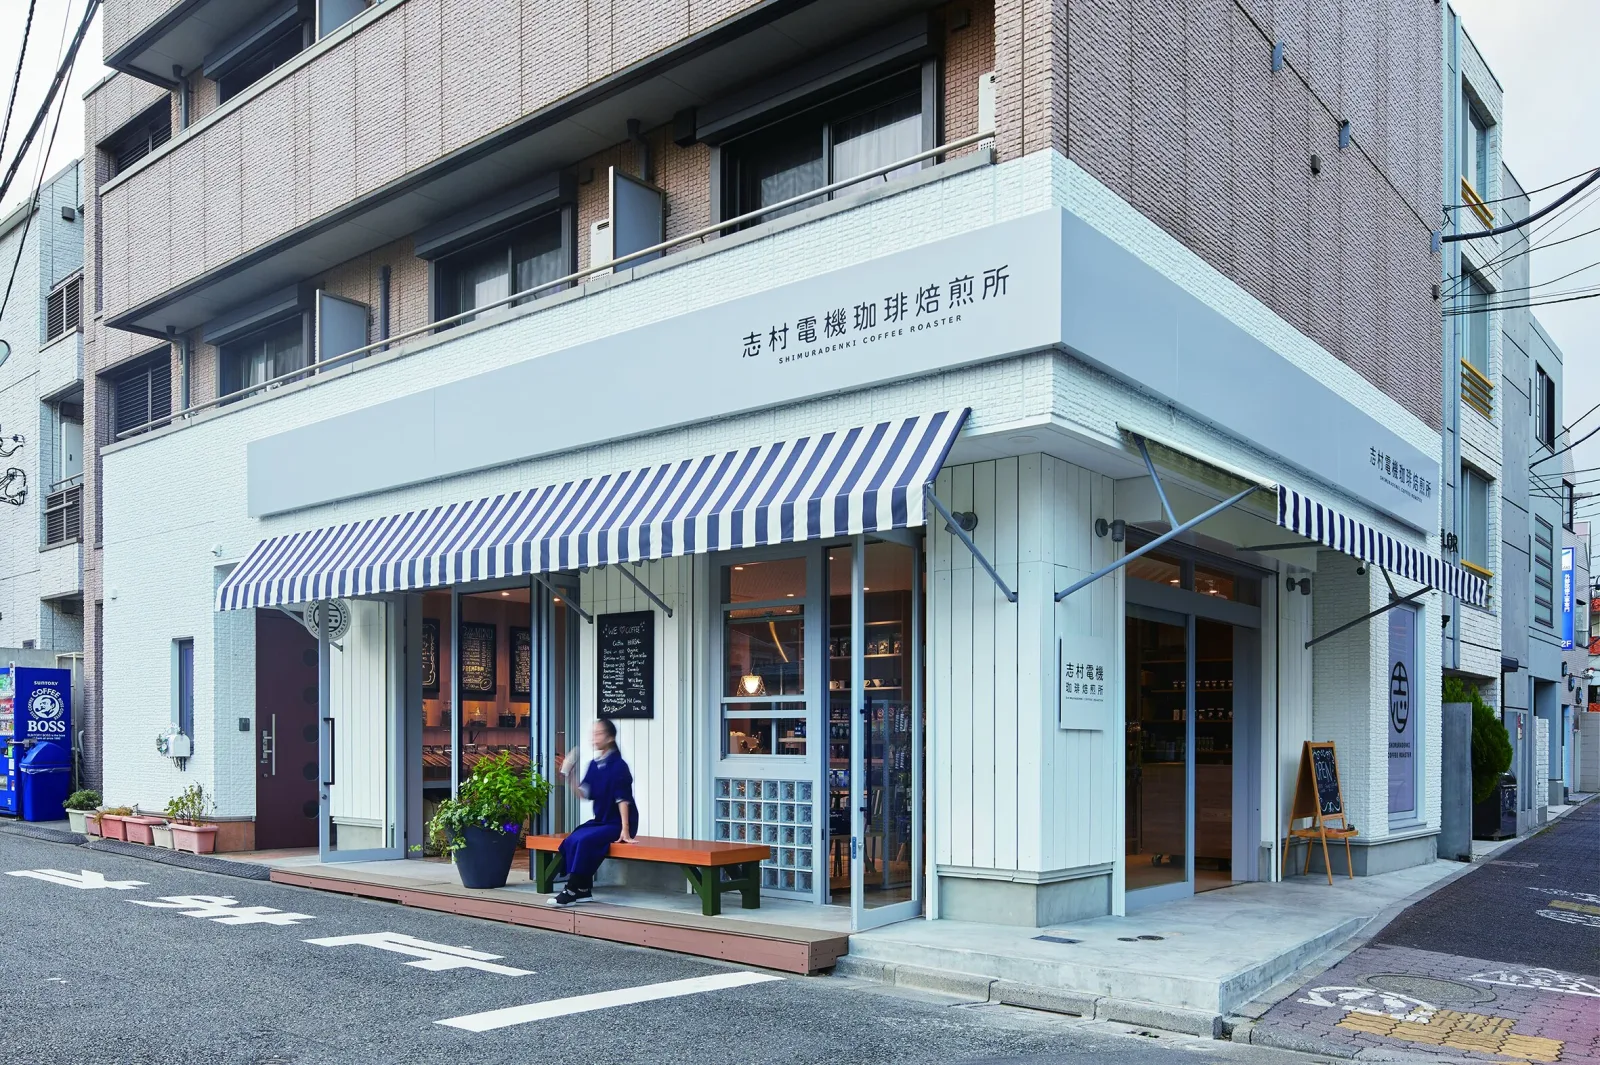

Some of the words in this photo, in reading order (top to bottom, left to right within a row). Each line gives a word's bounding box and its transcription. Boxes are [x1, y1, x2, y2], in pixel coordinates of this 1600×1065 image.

[742, 265, 1009, 358] 志村電機珈琲焙煎所
[778, 339, 857, 364] SHIMURADENKI
[862, 328, 904, 344] COFFEE
[909, 314, 962, 333] ROASTER
[1369, 446, 1431, 498] 志村電機珈琲焙煎所
[1561, 640, 1572, 648] 2F
[1066, 662, 1104, 681] 志村電機
[31, 687, 61, 699] COFFEE
[1065, 682, 1104, 696] 珈琲焙煎所
[27, 720, 66, 733] BOSS
